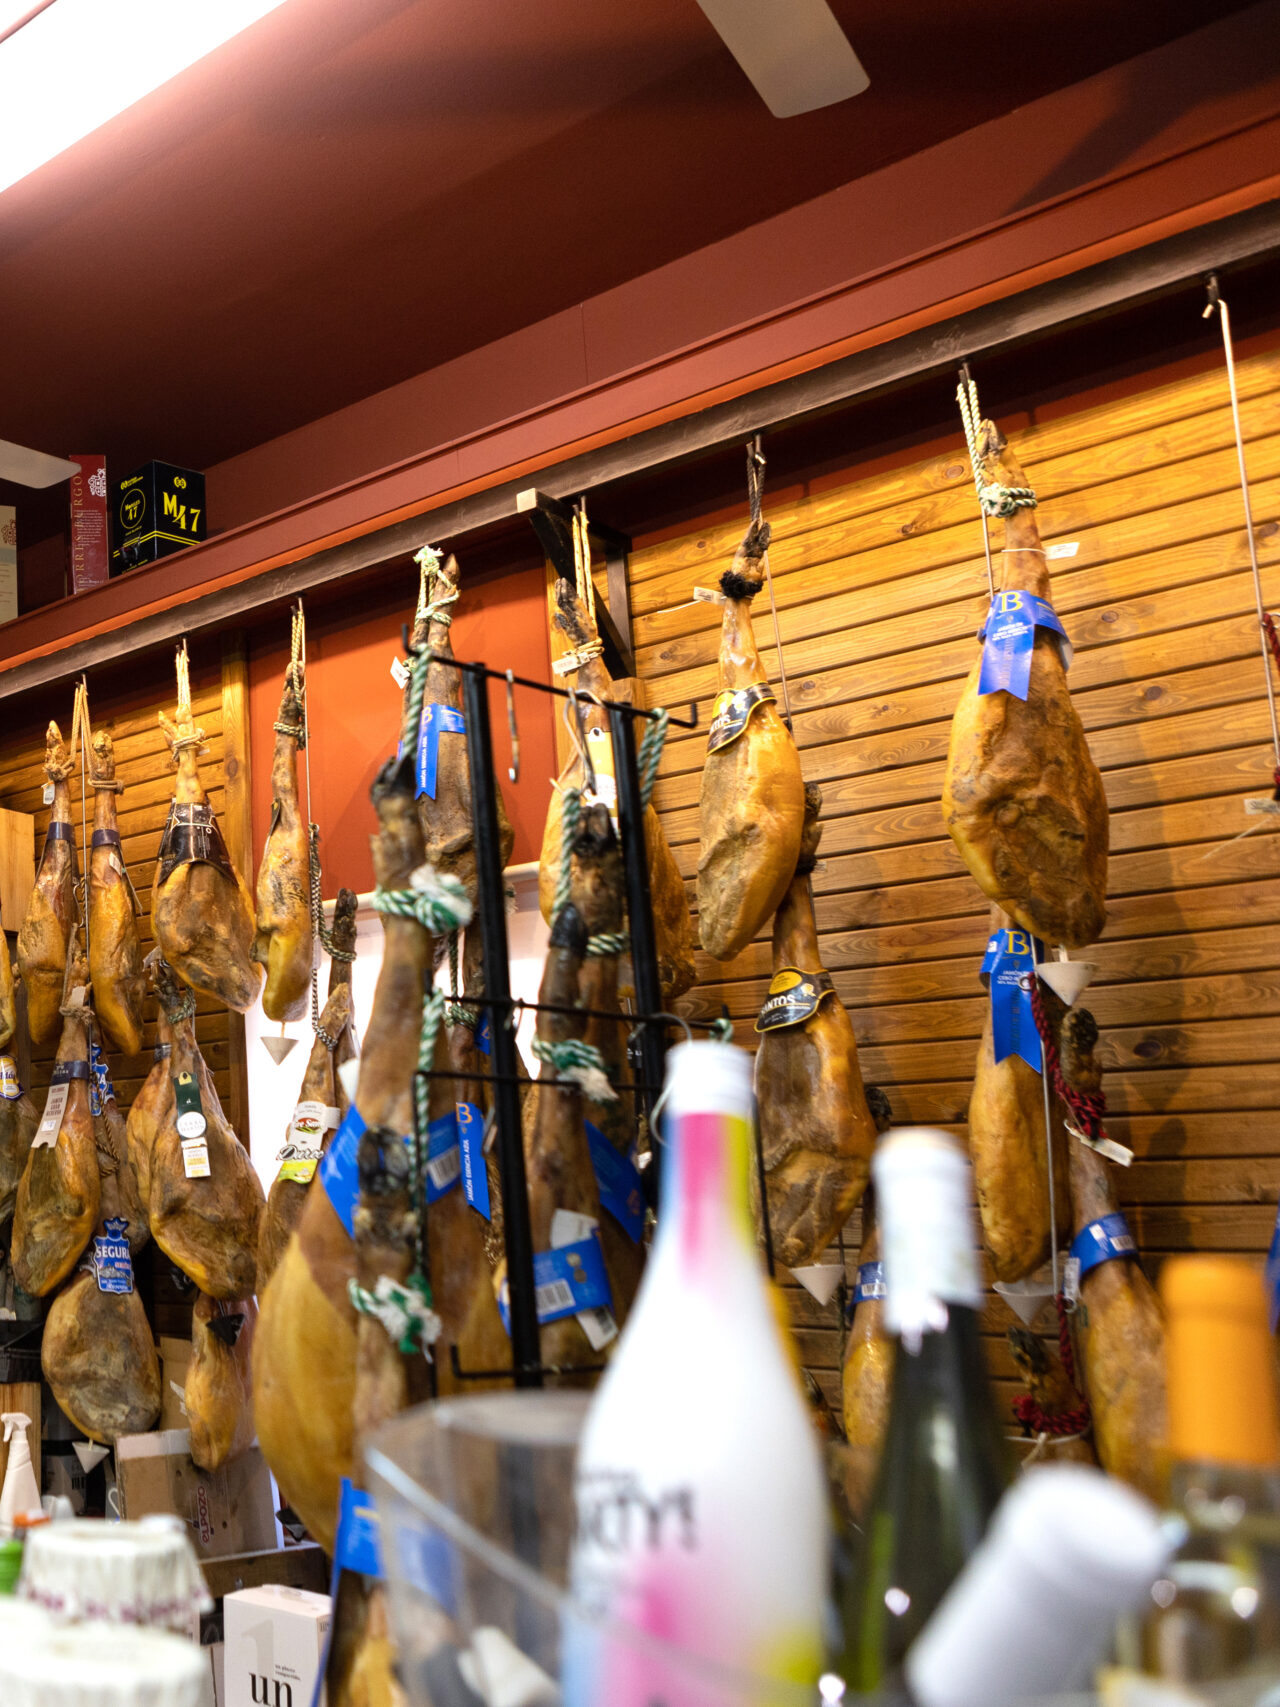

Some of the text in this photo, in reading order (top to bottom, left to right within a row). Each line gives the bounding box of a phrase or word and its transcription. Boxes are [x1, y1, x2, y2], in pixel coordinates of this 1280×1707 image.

[74, 475, 84, 529] BURGO
[999, 592, 1023, 613] B
[1005, 930, 1030, 955] B
[456, 1102, 473, 1123] B
